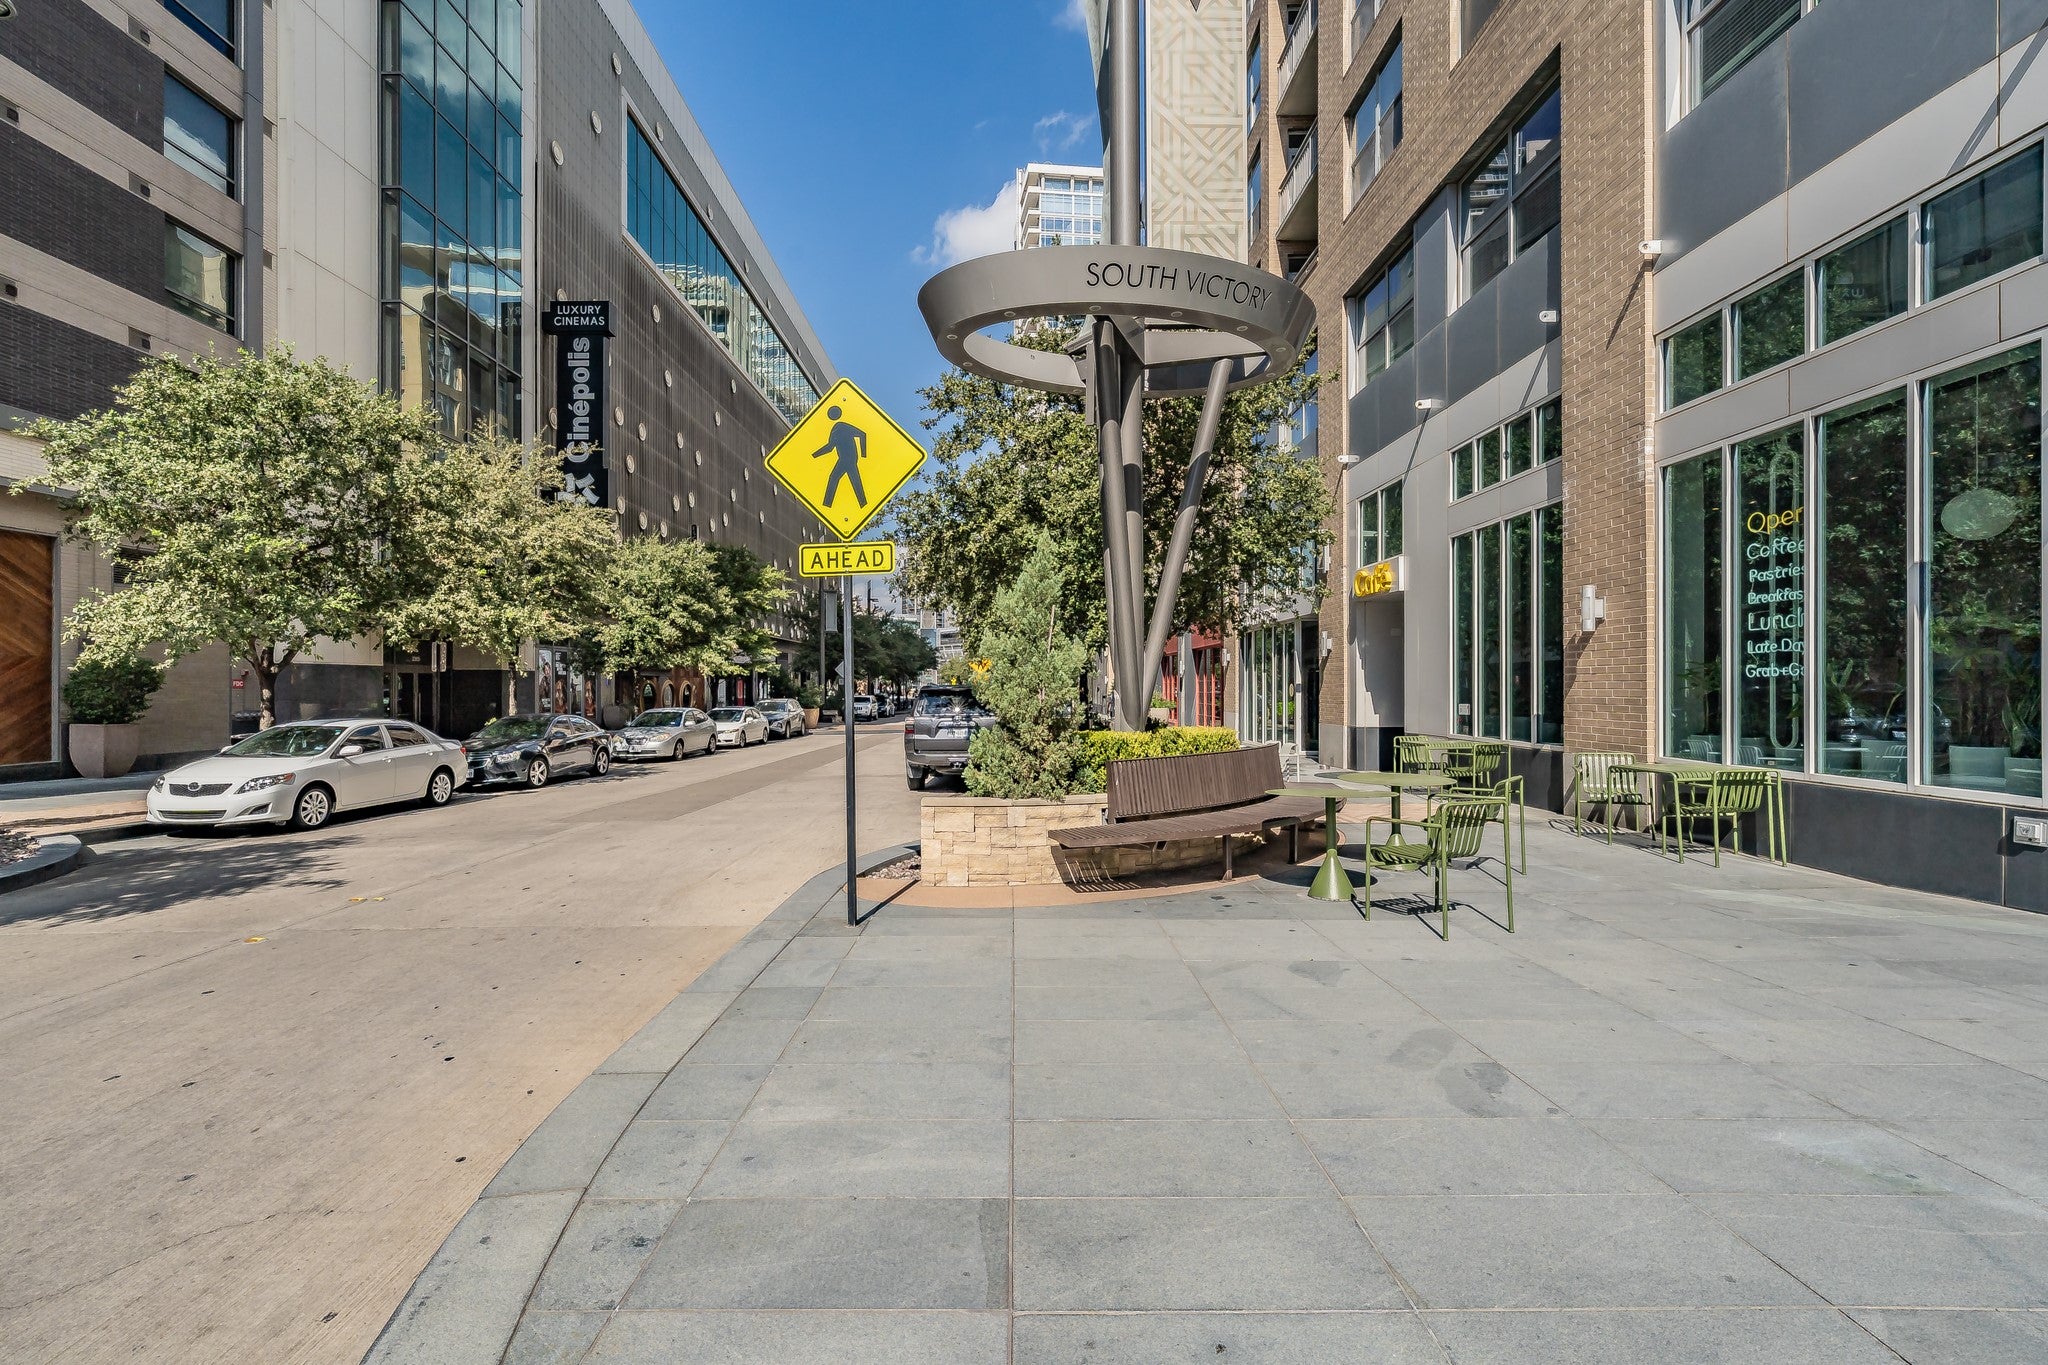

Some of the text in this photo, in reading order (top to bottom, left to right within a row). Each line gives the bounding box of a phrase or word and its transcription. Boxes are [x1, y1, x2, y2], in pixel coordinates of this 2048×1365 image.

[1086, 262, 1273, 311] SOUTH VICTORY
[557, 305, 601, 315] LUXURY
[553, 316, 605, 326] CINEMAS
[566, 337, 595, 463] Cinépolis
[811, 550, 884, 569] AHEAD
[1354, 563, 1392, 597] Café
[1747, 640, 1778, 654] Late
